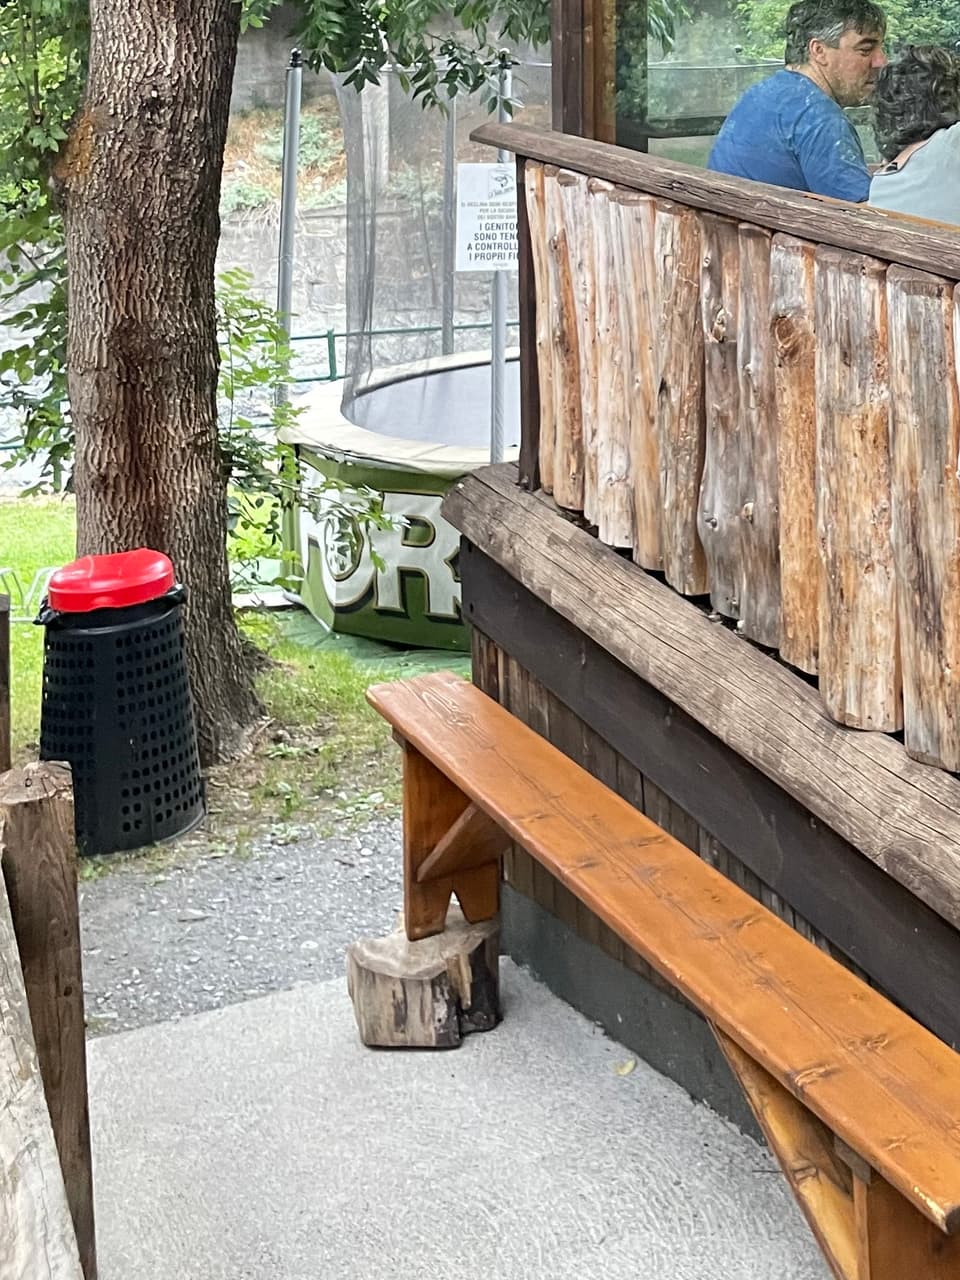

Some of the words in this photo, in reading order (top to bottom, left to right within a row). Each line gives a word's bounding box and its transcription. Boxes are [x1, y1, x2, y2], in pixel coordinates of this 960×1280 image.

[474, 232, 497, 241] SONO
[467, 242, 473, 251] A
[474, 242, 518, 251] CONTROLL
[474, 252, 506, 261] PROPRI
